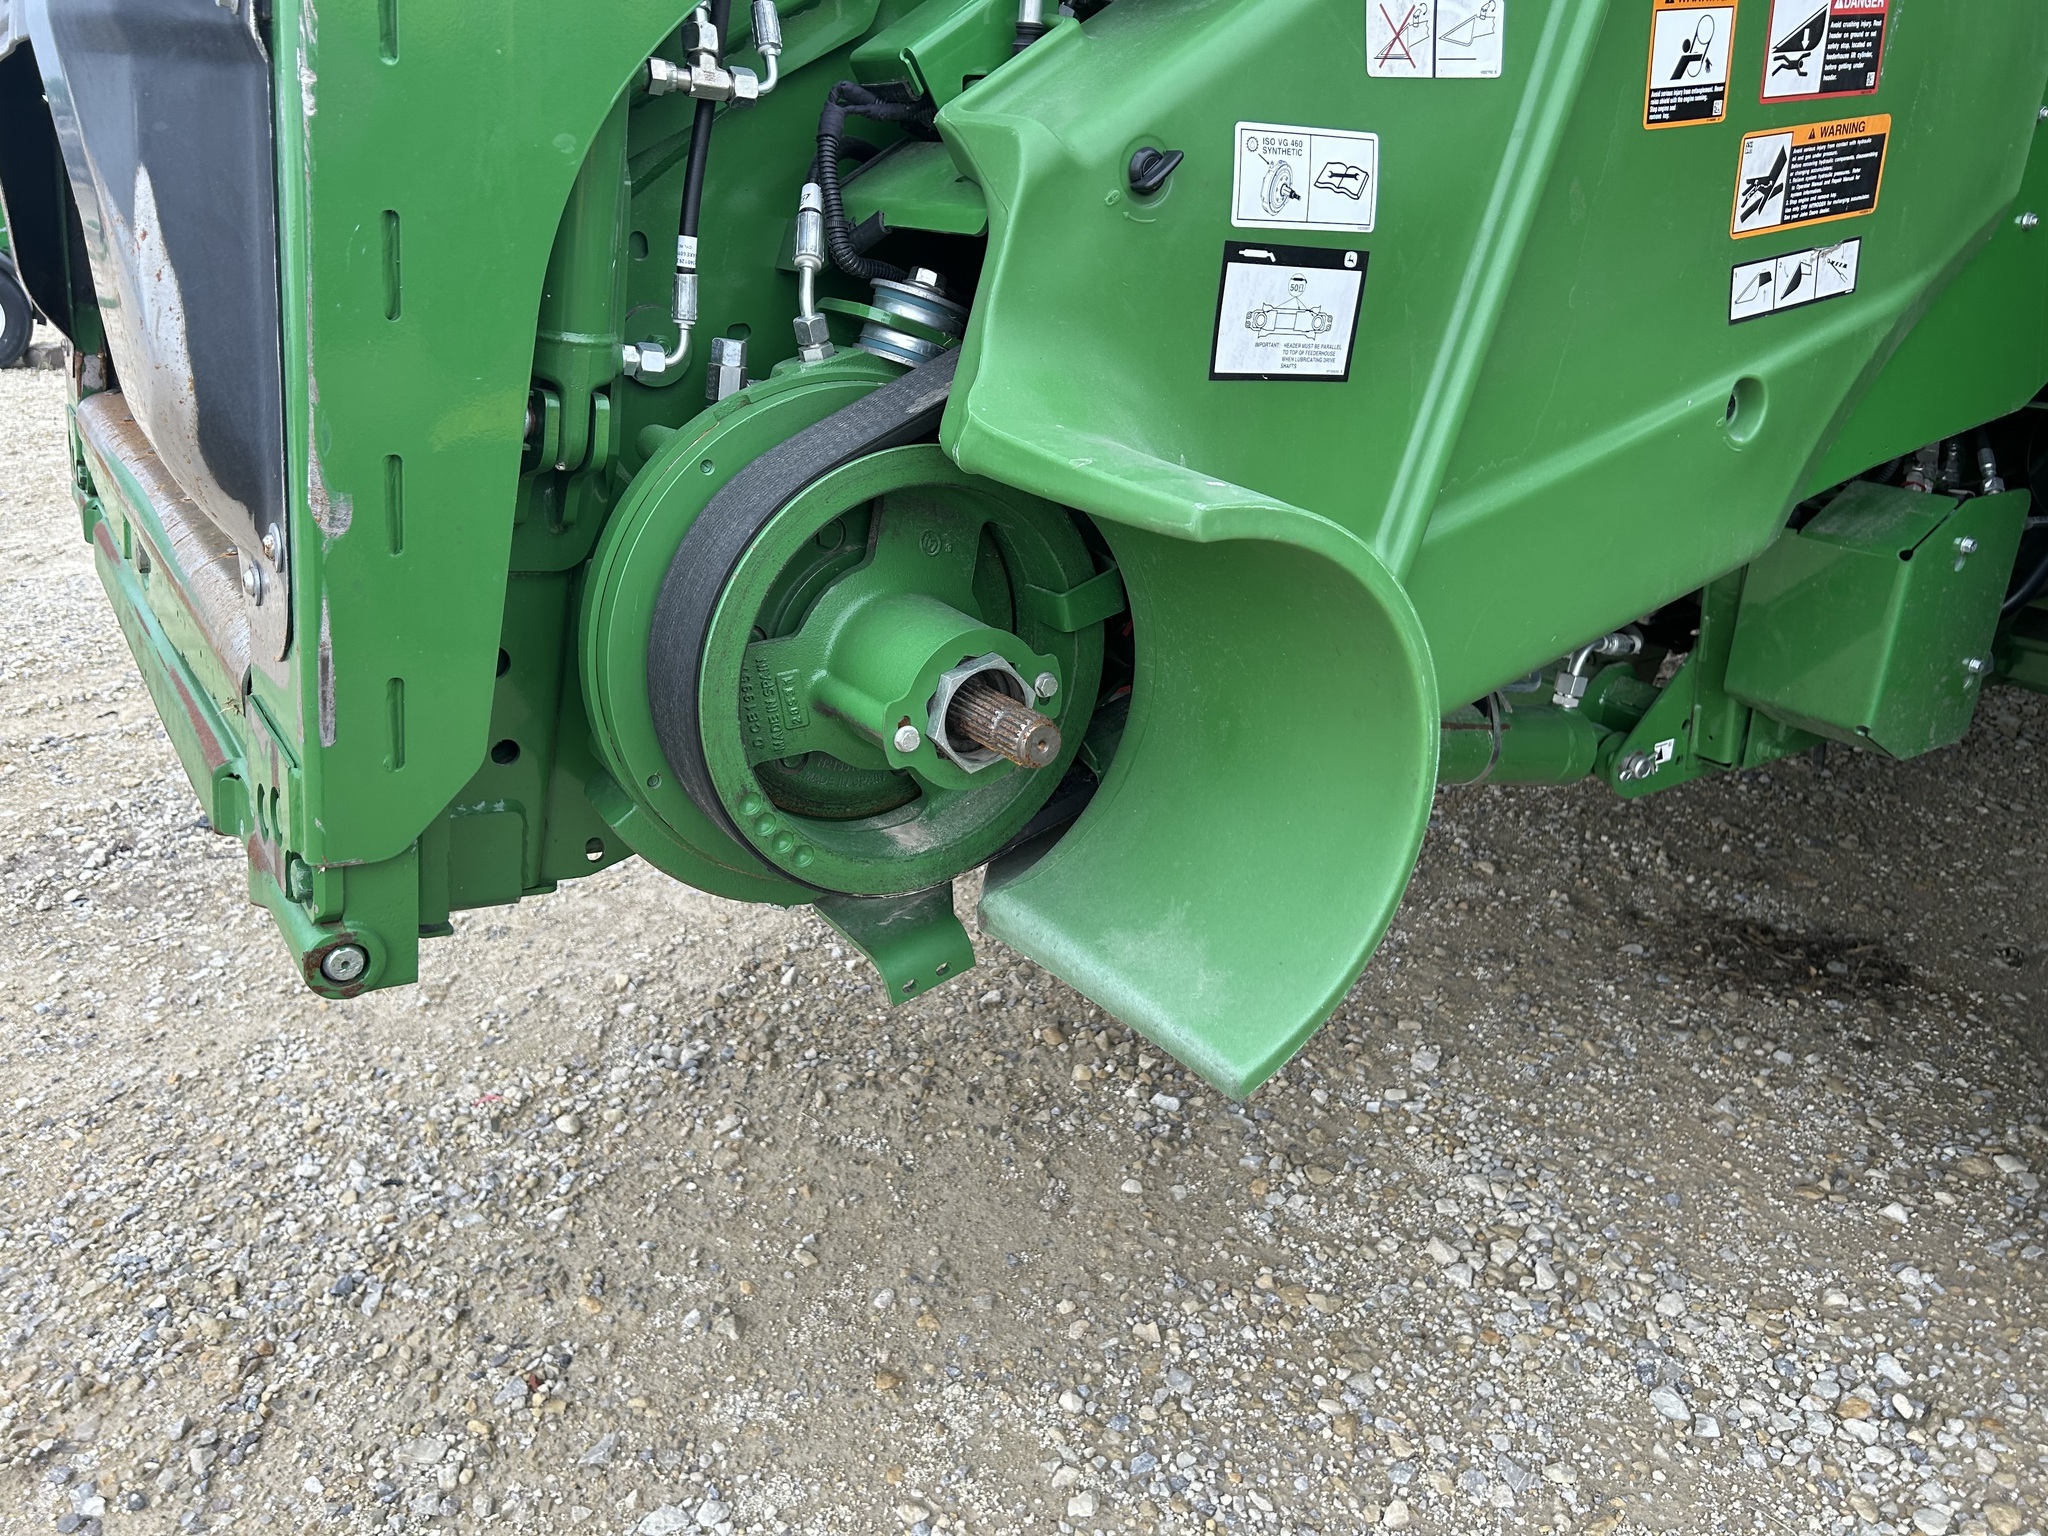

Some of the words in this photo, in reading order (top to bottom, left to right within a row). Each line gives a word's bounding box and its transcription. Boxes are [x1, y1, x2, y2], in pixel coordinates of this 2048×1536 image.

[1820, 121, 1866, 138] WARNING
[1262, 137, 1275, 146] ISO
[1278, 138, 1289, 147] VG
[1290, 139, 1303, 148] 460
[1262, 146, 1303, 157] SYNTHETIC
[1255, 341, 1281, 349] IMPORTANT:
[1320, 343, 1342, 351] PARALLEL
[756, 658, 775, 697] SPAIN
[765, 699, 779, 713] IN
[768, 713, 786, 751] MADE
